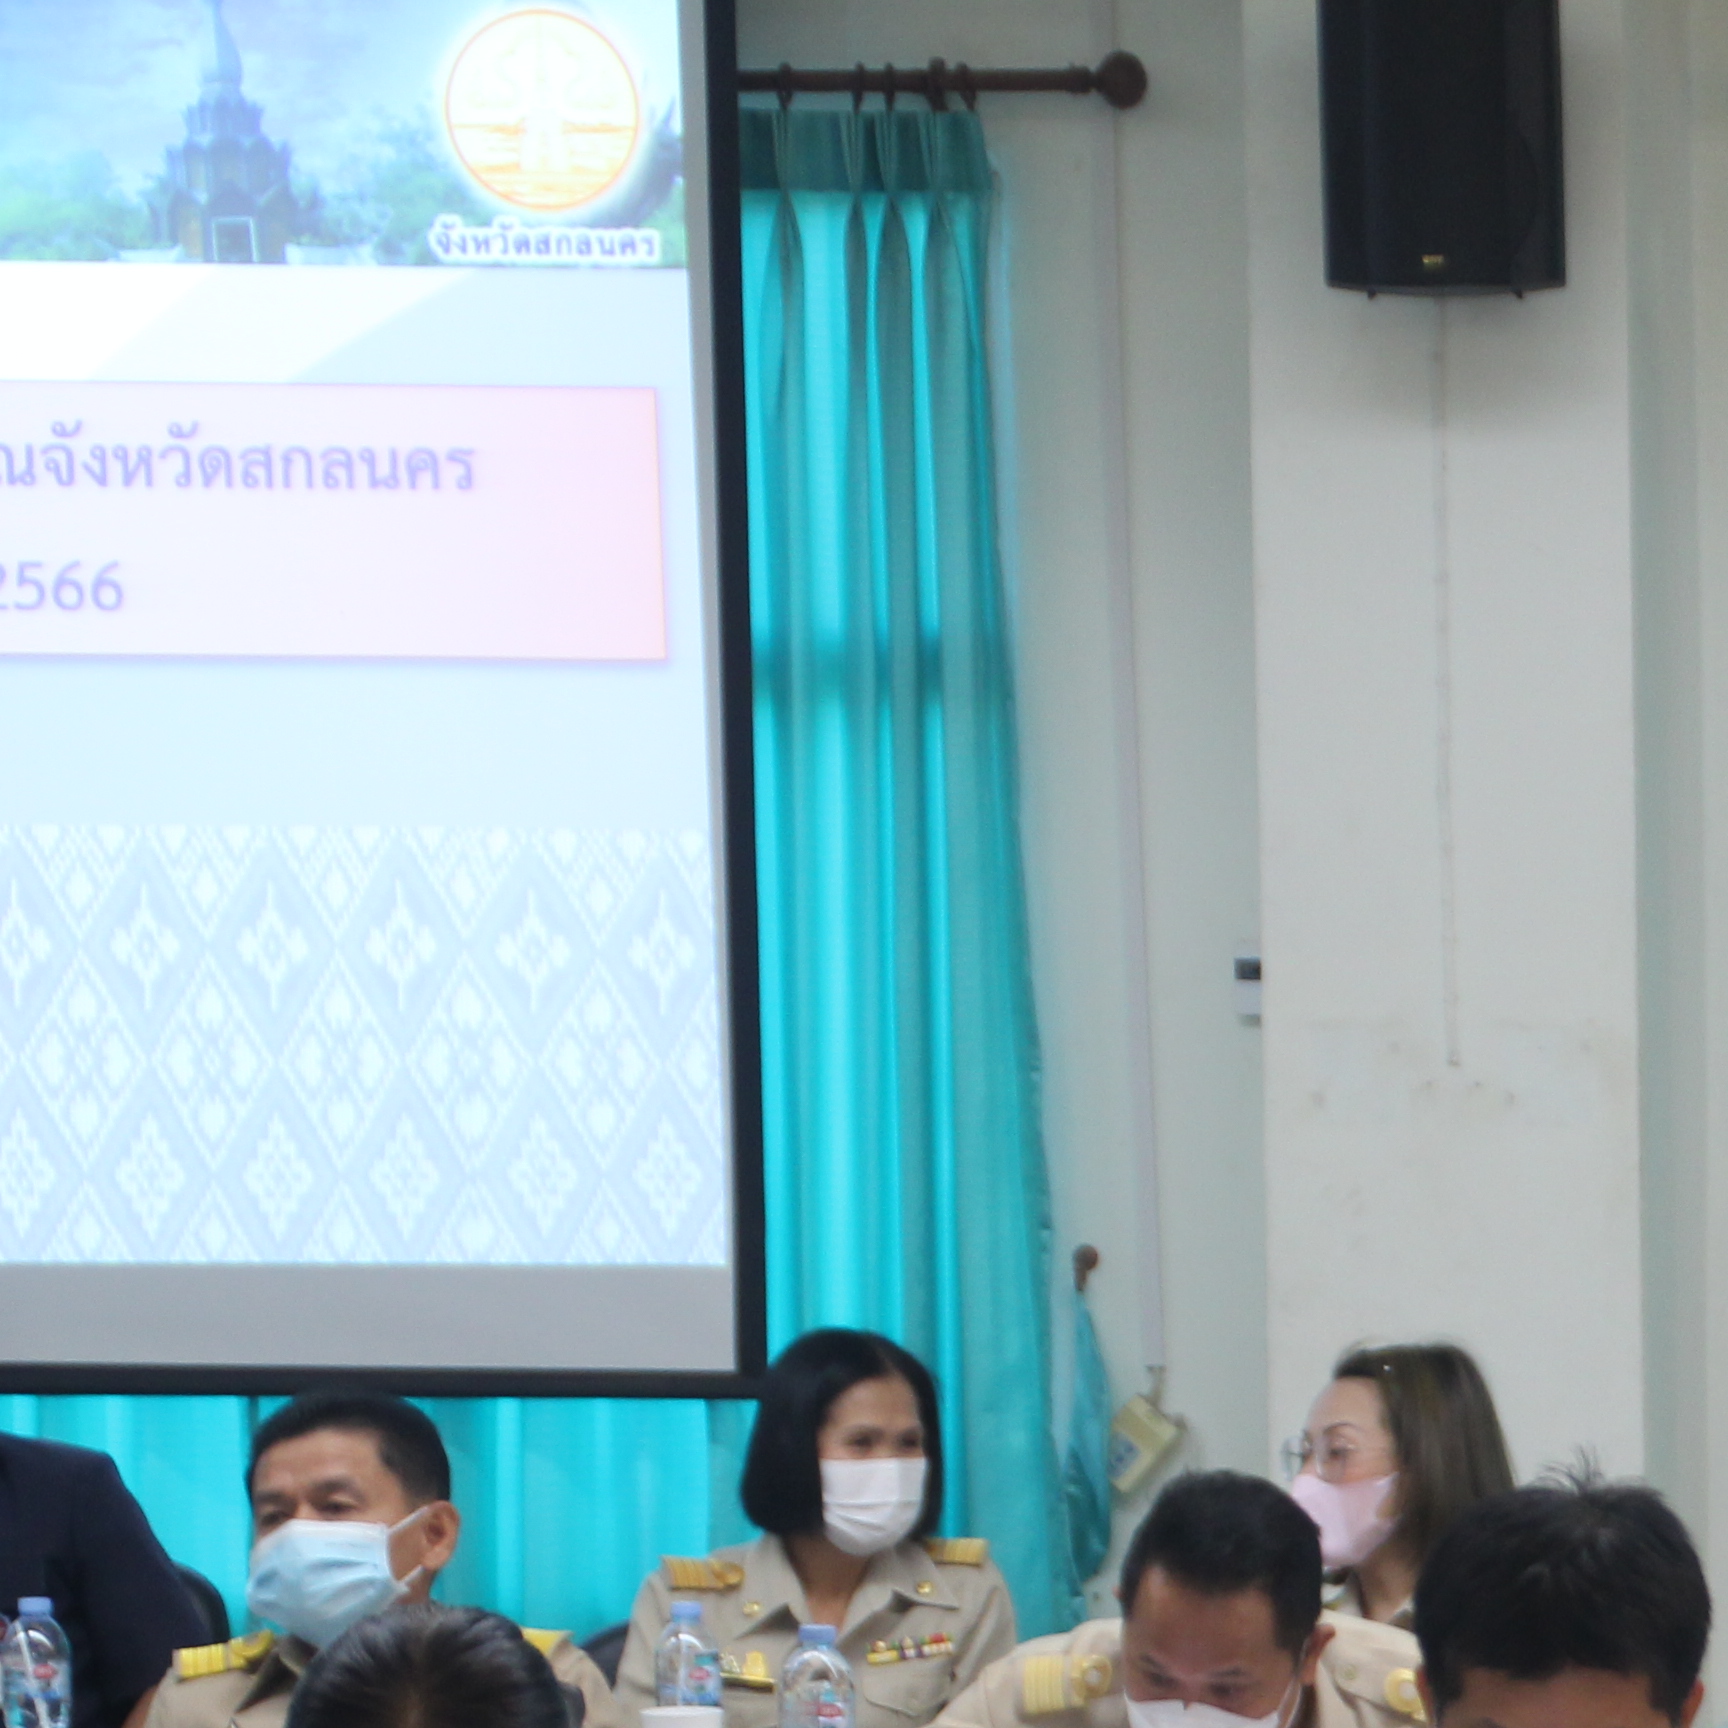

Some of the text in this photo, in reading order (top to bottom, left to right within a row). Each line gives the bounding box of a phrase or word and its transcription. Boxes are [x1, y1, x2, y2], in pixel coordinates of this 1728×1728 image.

[436, 221, 656, 257] จังหวัดสกลนคร
